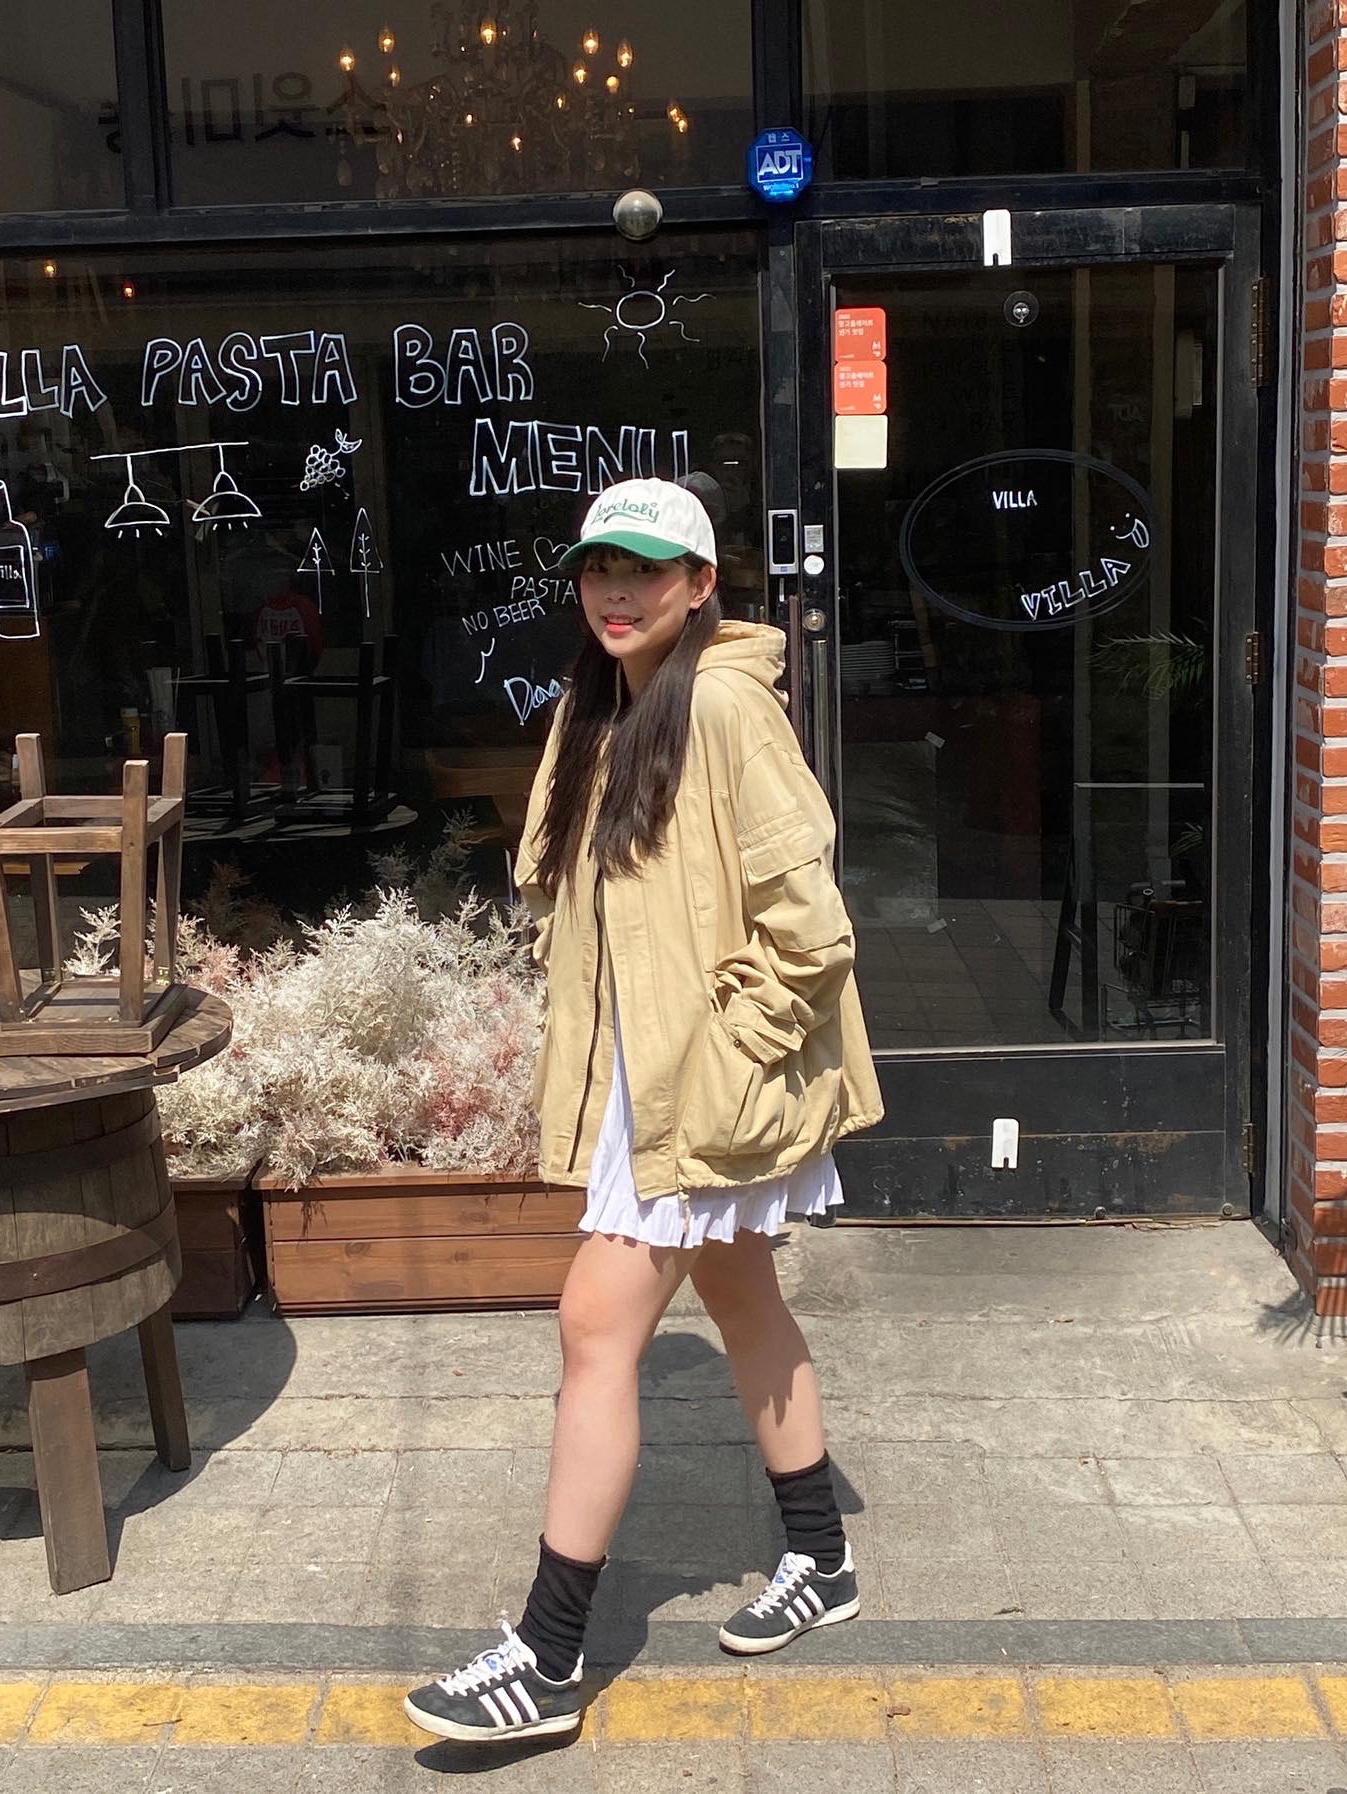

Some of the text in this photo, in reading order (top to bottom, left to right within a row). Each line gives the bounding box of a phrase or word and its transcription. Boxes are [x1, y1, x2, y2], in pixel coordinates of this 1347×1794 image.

[758, 150, 802, 175] ADT
[141, 330, 357, 411] PASTA
[394, 322, 534, 408] BAR
[469, 418, 688, 496] MENU
[992, 489, 1038, 510] VILLA
[441, 540, 523, 577] WINE
[510, 575, 578, 605] PASTA
[1020, 557, 1132, 621] VILLA
[461, 598, 547, 636] NO BEER
